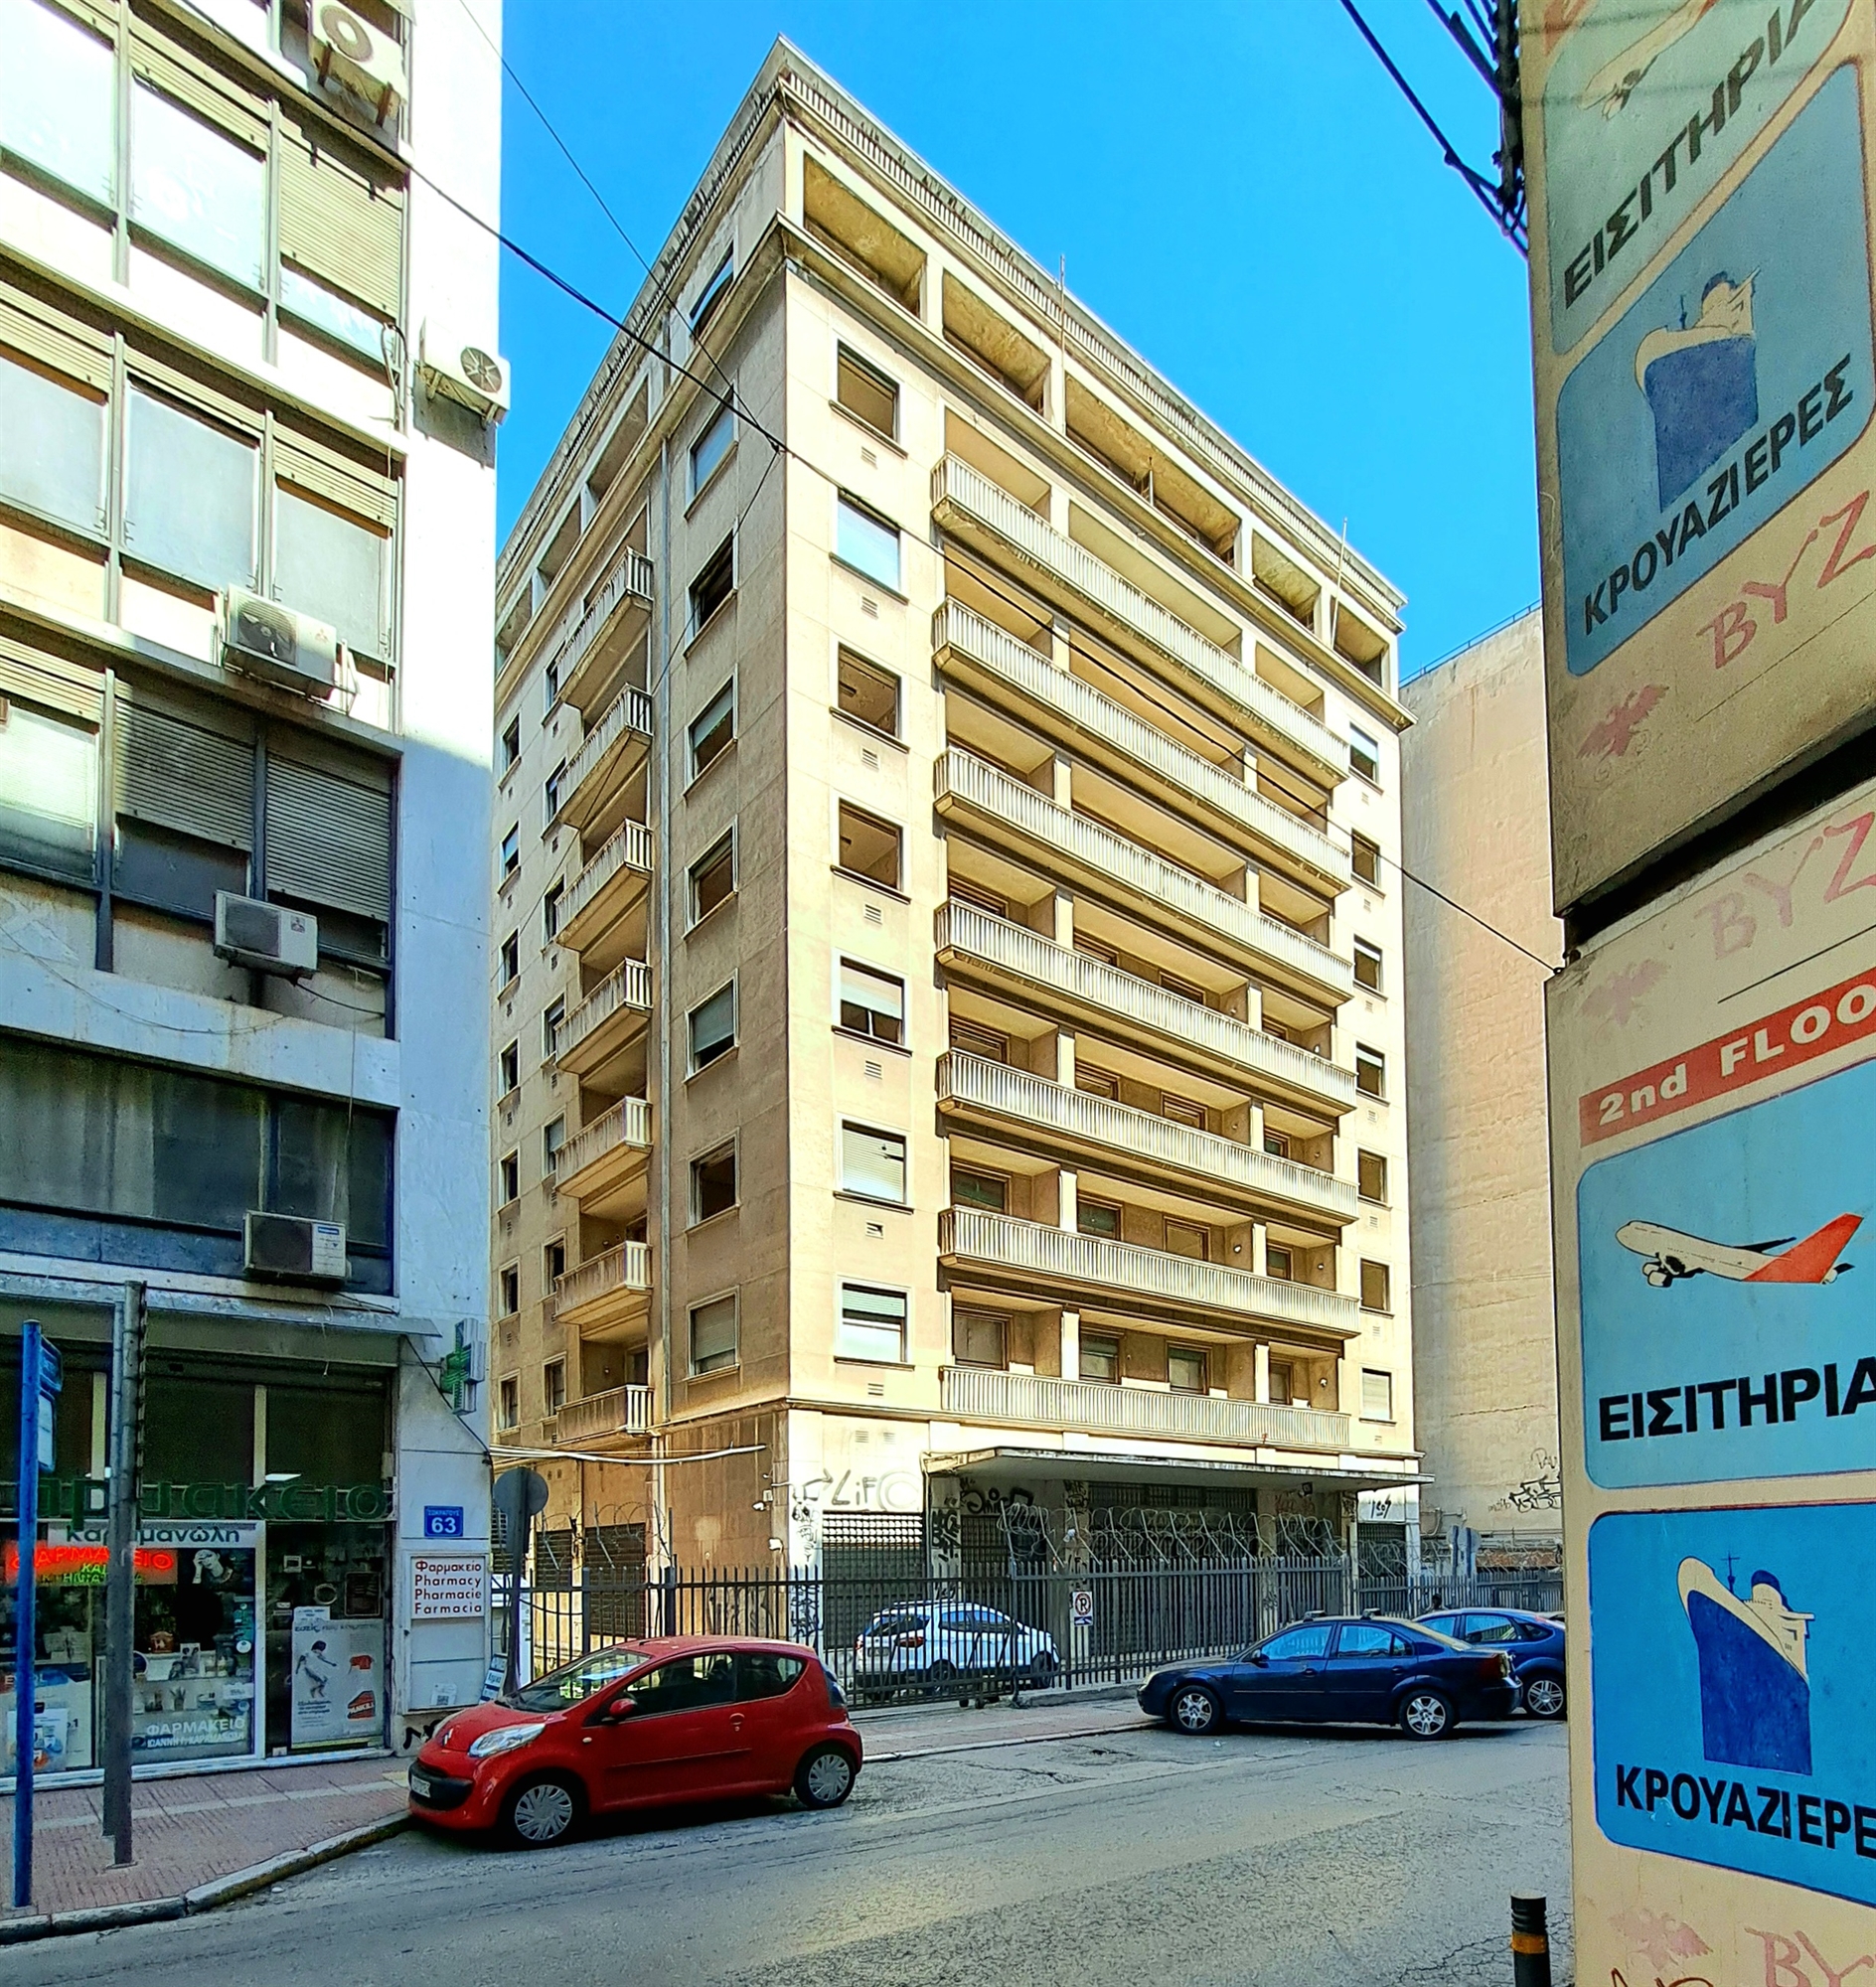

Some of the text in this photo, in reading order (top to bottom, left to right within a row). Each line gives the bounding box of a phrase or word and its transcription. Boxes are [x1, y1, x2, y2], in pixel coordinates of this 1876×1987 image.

[1583, 354, 1854, 635] ΚΡΟΥΑΖΙΕΡΕΣ
[1599, 984, 1876, 1126] 2nd FLOO
[1599, 1356, 1876, 1442] ΕΙΣΙΤΗΡΙΑ
[431, 1517, 457, 1533] 63
[10, 1547, 174, 1570] ΑΡΜΑΕΙΟ
[415, 1560, 482, 1575] Φαρμακείο
[414, 1575, 482, 1588] Pharmacy
[414, 1589, 482, 1601] Pharmacie
[414, 1603, 482, 1614] Farmacia
[146, 1718, 245, 1736] ΦΑΡΜΑΚΕΙΟ
